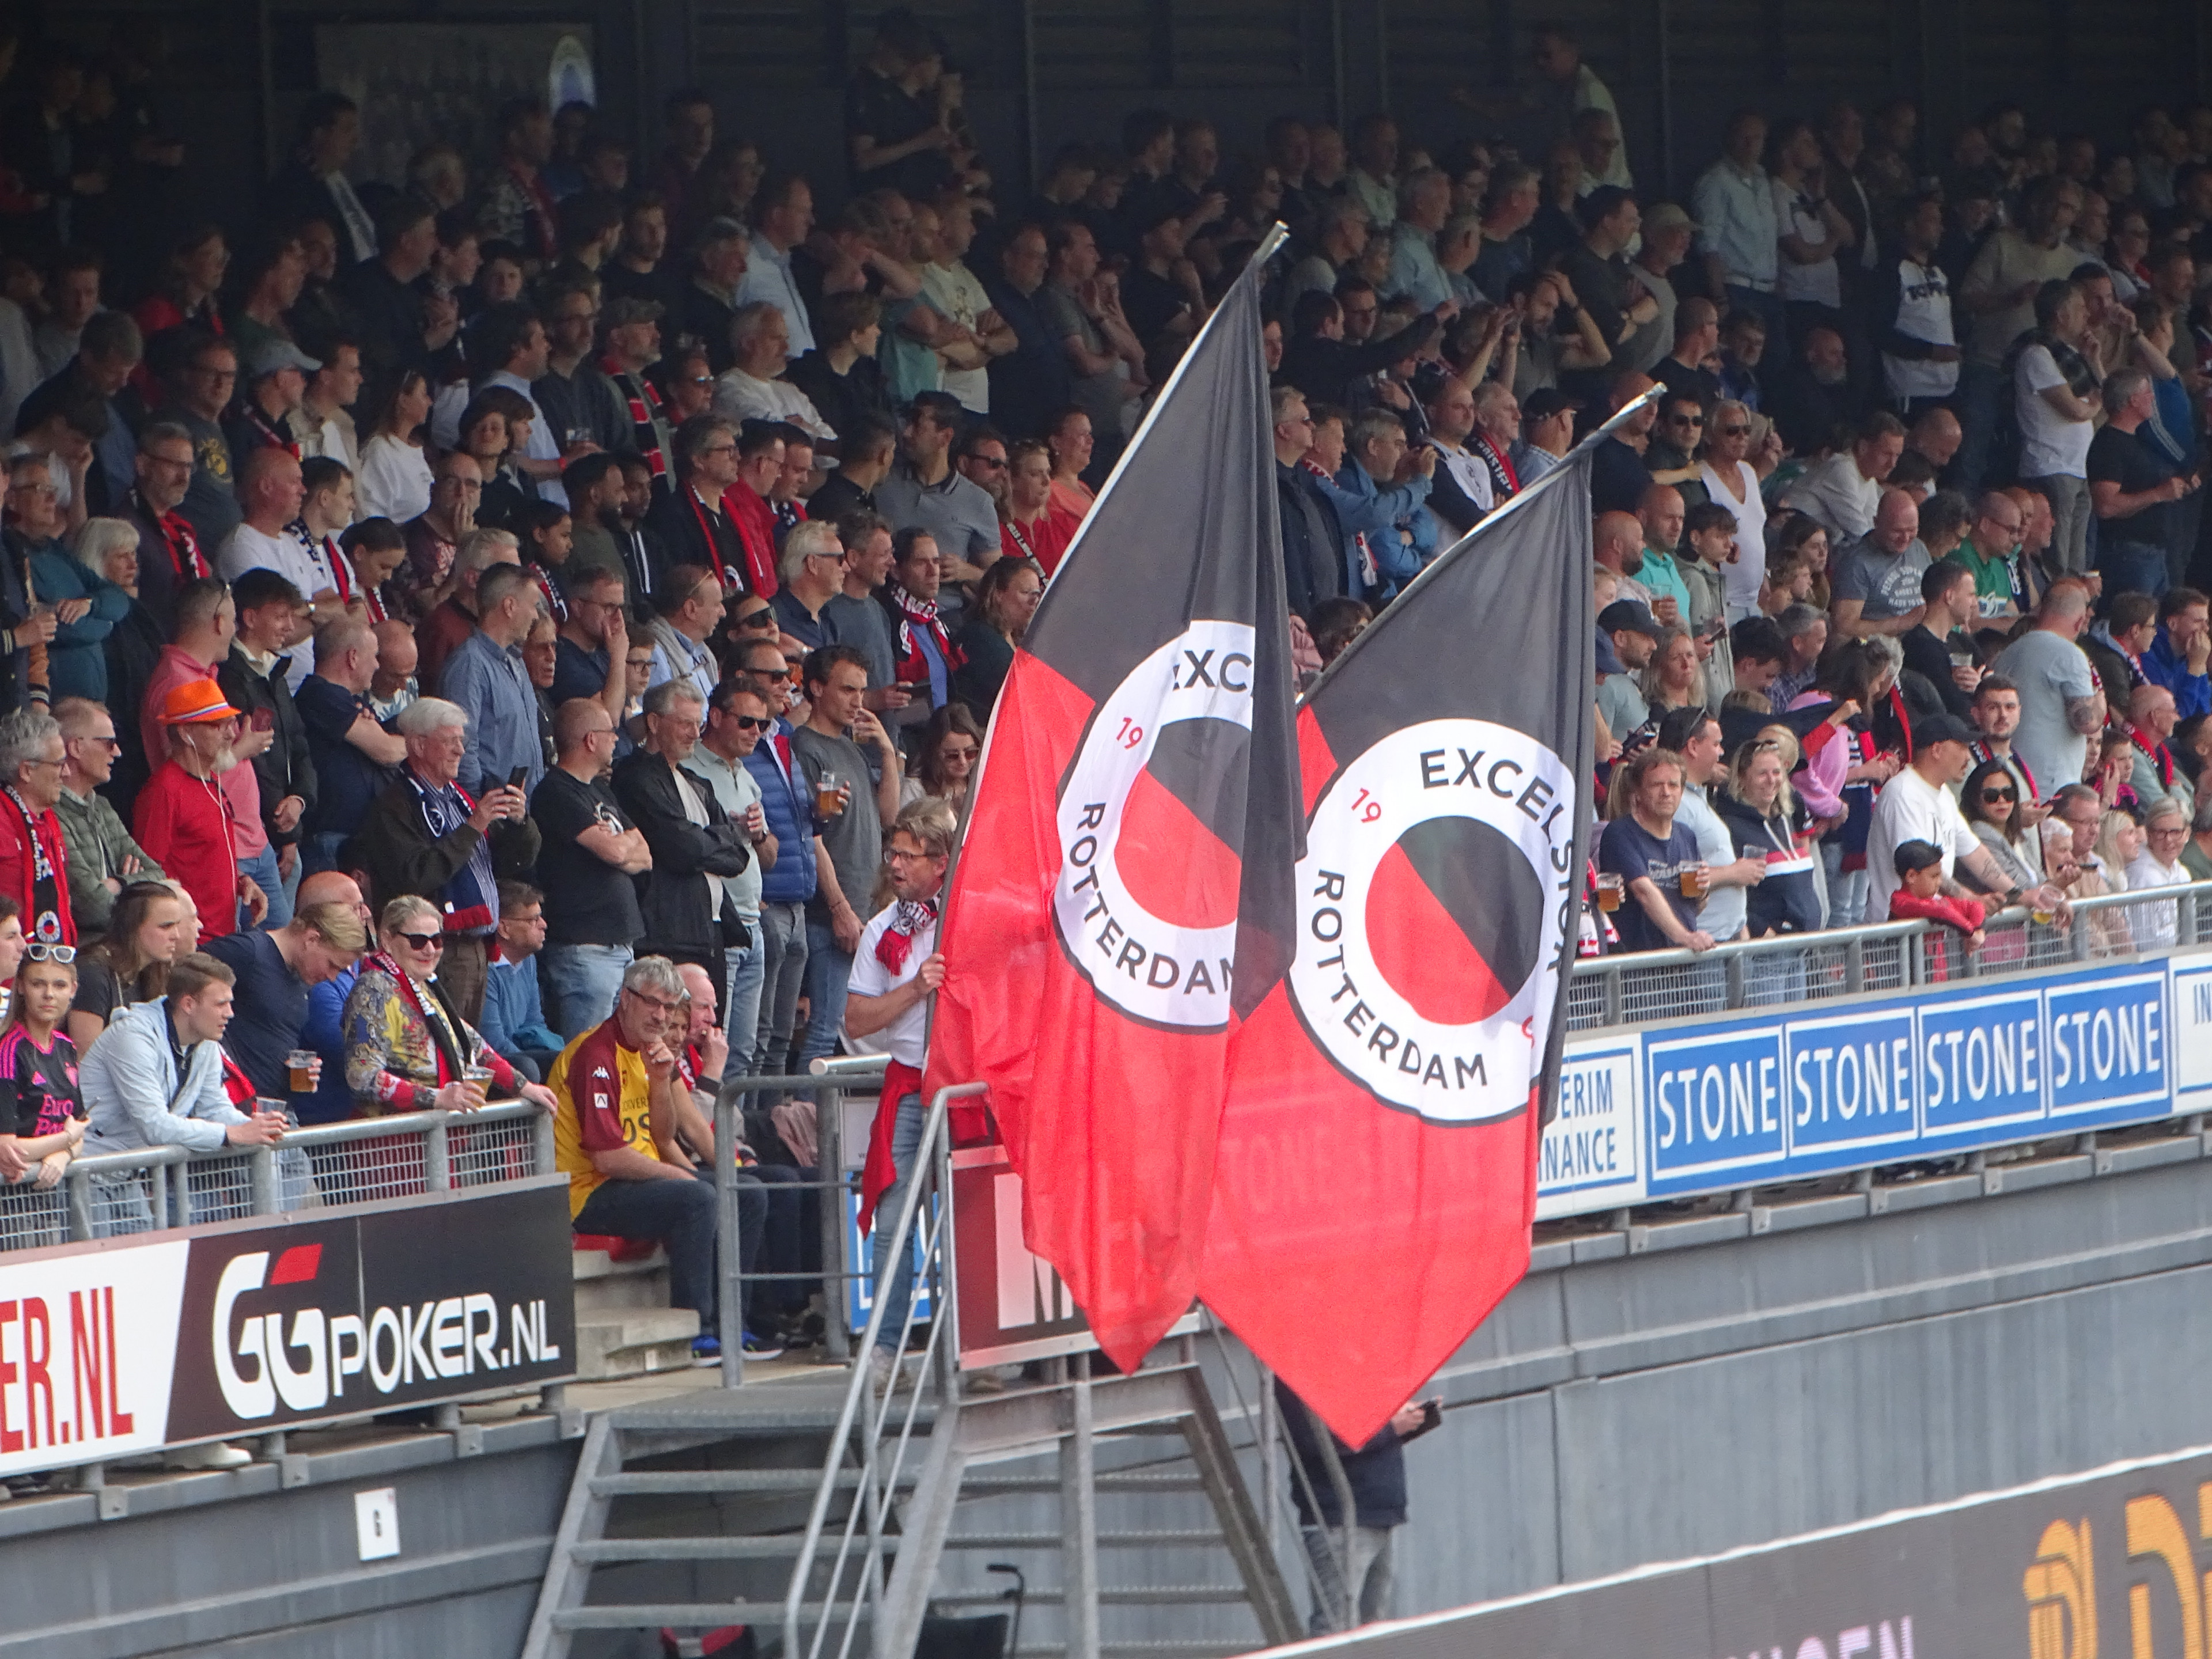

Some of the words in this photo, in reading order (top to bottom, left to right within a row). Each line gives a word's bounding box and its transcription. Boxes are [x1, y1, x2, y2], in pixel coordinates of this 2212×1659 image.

[1116, 717, 1143, 749] 19
[1351, 787, 1381, 824] 19
[1311, 868, 1488, 1090] ROTTERDAM
[1794, 1037, 1910, 1127] STONE
[1926, 1019, 2037, 1108] STONE
[2053, 1001, 2161, 1089] STONE
[1658, 1056, 1778, 1149] STONE
